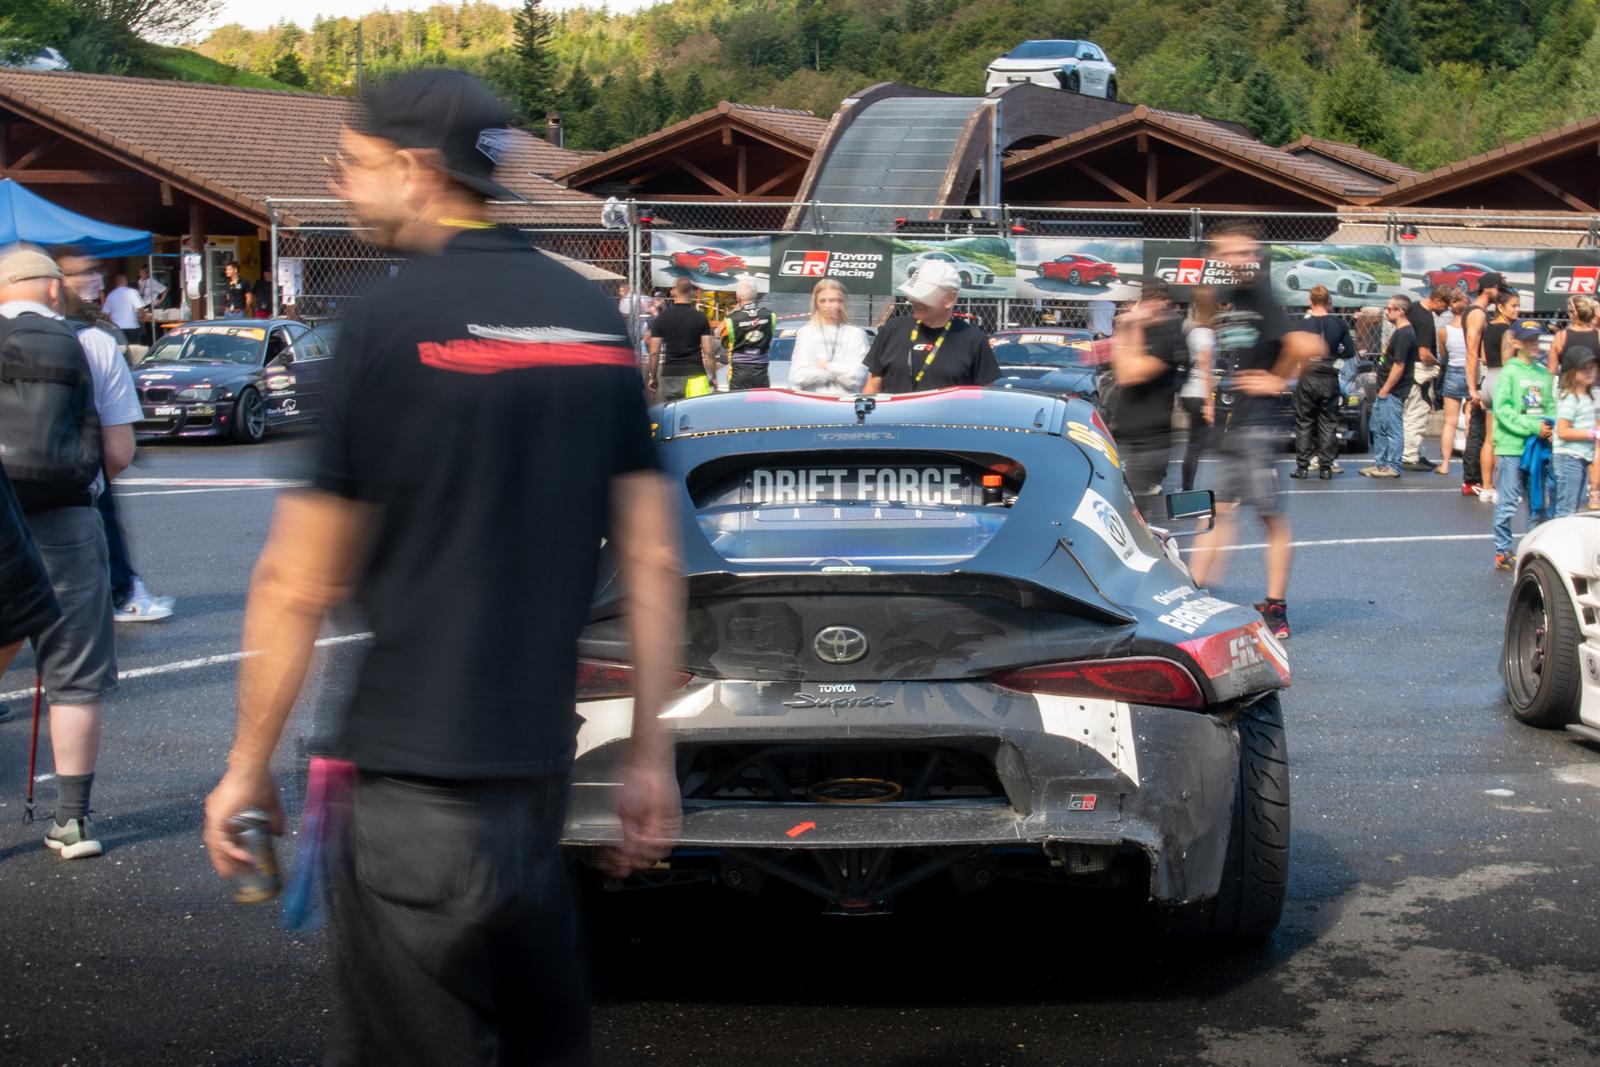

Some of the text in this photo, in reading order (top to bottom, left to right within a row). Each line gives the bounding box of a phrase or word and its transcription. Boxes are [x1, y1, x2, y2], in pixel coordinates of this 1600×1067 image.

[831, 252, 883, 262] TOYOTA
[828, 260, 878, 270] GAZOO
[826, 268, 875, 279] Racing
[753, 467, 962, 505] DRIFT FORCE
[818, 684, 857, 693] TOYOTA
[782, 692, 895, 717] Supra
